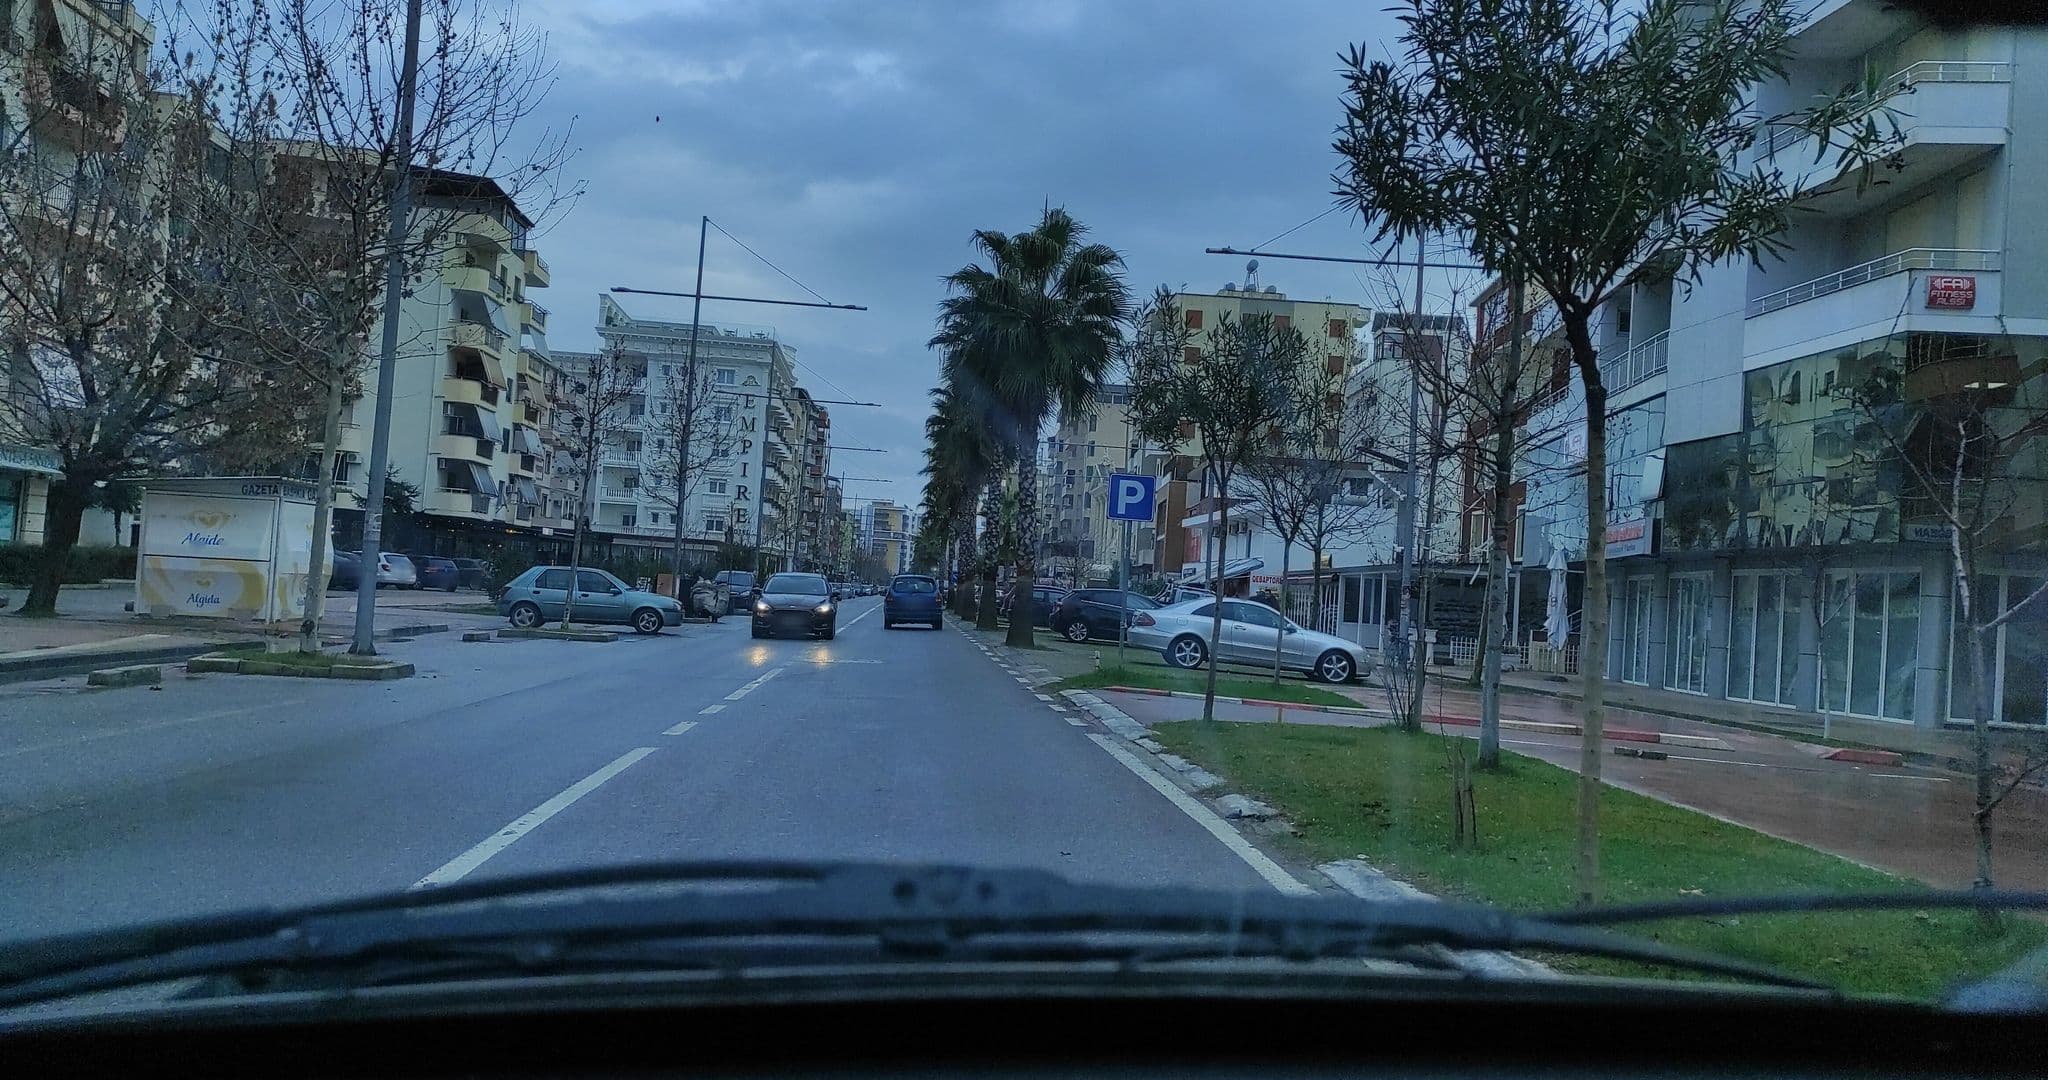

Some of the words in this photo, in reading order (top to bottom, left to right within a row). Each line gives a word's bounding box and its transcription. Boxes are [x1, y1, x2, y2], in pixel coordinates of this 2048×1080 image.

[1930, 290, 1973, 298] FITNESS
[735, 394, 757, 523] EMPIRE
[241, 484, 279, 495] GAZETA
[1117, 480, 1145, 514] P
[186, 592, 221, 608] Algida
